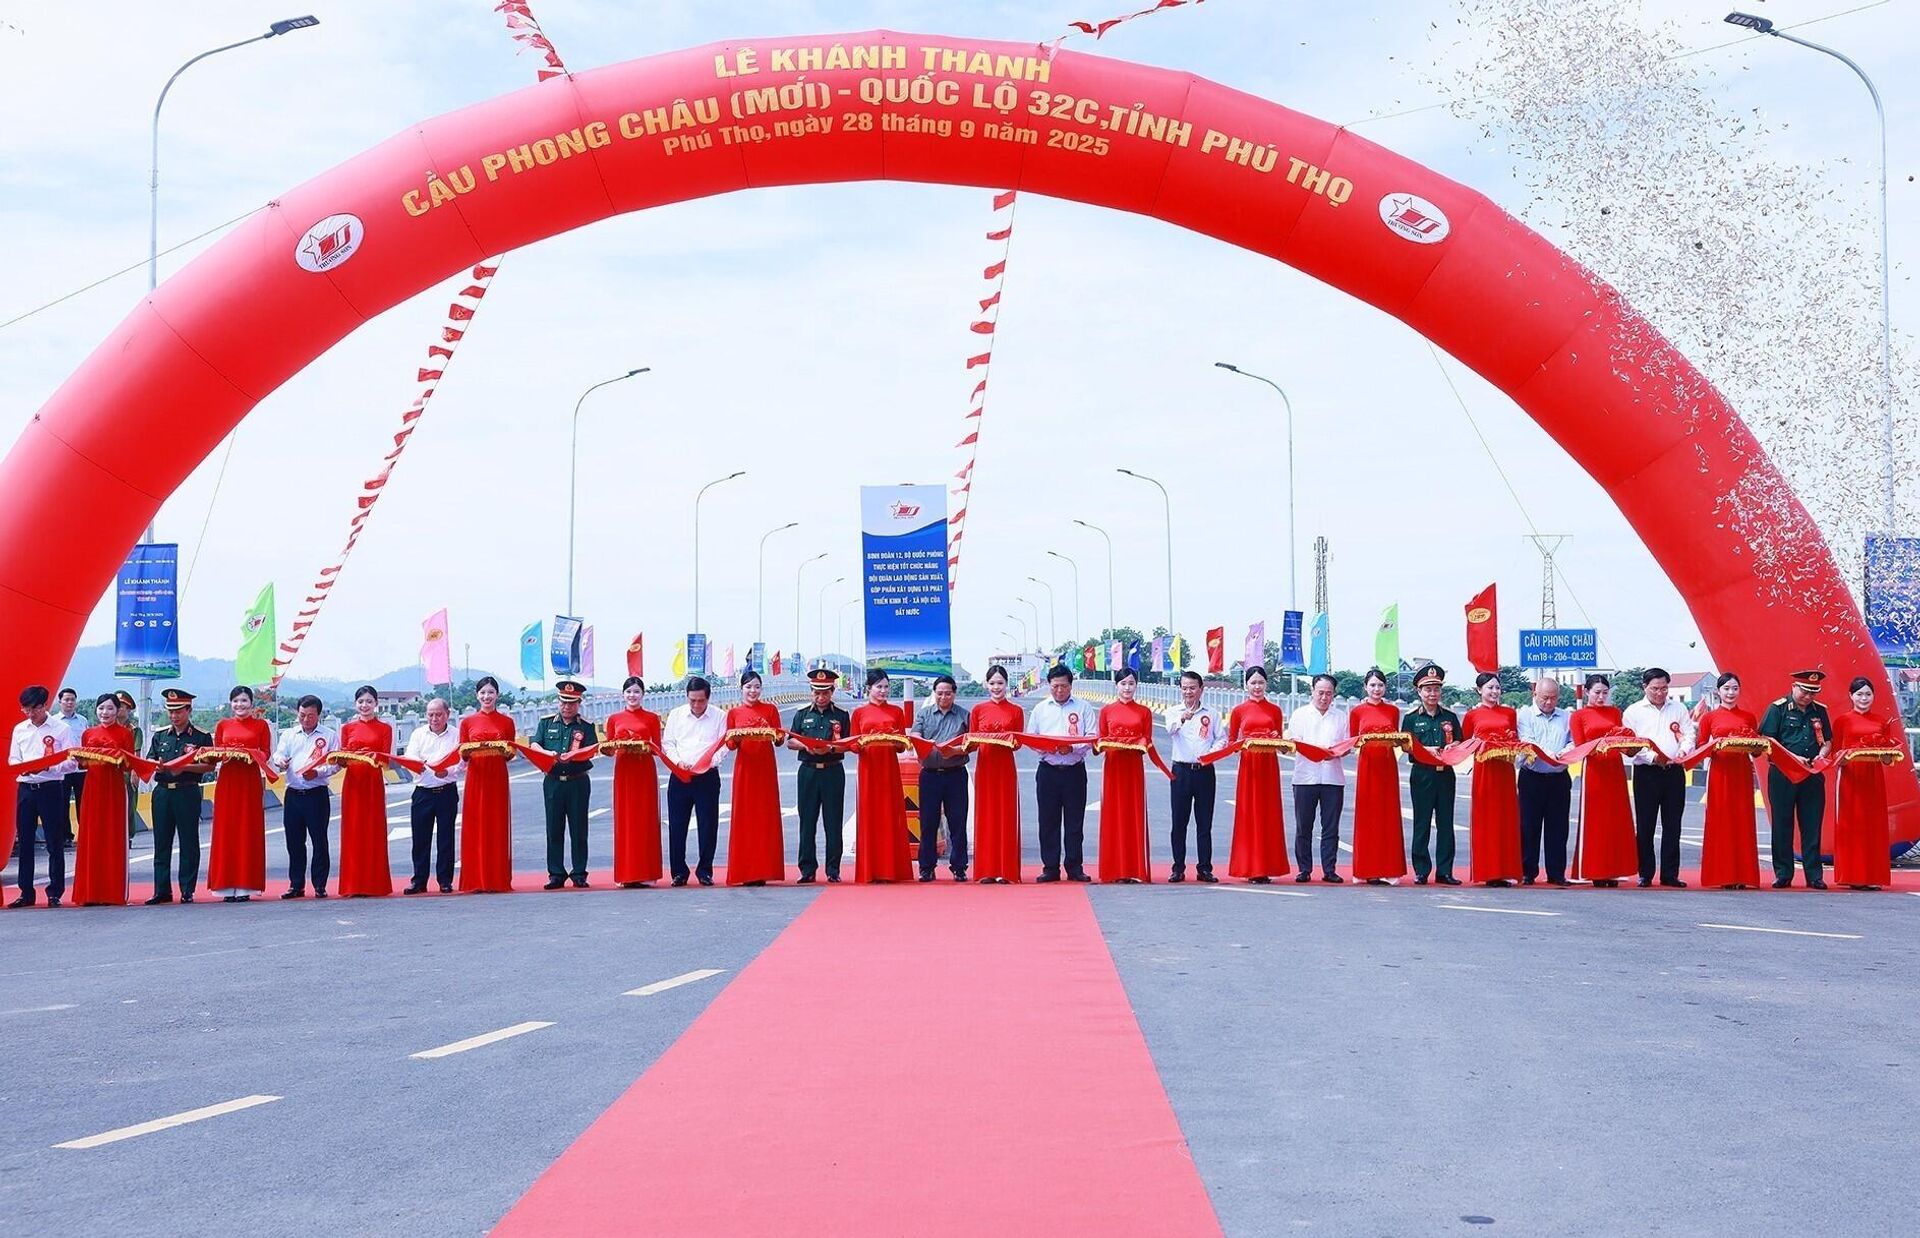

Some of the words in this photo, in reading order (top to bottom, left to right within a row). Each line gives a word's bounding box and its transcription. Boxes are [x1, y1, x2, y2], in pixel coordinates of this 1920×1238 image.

[771, 43, 906, 72] KHÁNH
[920, 47, 1051, 83] THÀNH
[401, 170, 477, 217] CẦU
[481, 121, 611, 182] PHONG
[618, 98, 721, 139] CHÂU
[730, 75, 832, 119] (MỚI)
[859, 71, 960, 106] QUỐC
[972, 80, 1018, 115] LỘ
[1200, 128, 1280, 174] PHÚ
[1286, 156, 1354, 208] THỌ
[662, 128, 712, 156] Phú
[774, 113, 834, 137] ngày
[842, 112, 873, 131] 28
[881, 113, 952, 137] tháng
[959, 119, 975, 138] 9
[983, 121, 1038, 145] năm
[1047, 129, 1110, 156] 2025
[1542, 635, 1570, 647] PHONG
[1572, 633, 1594, 647] CHÂU
